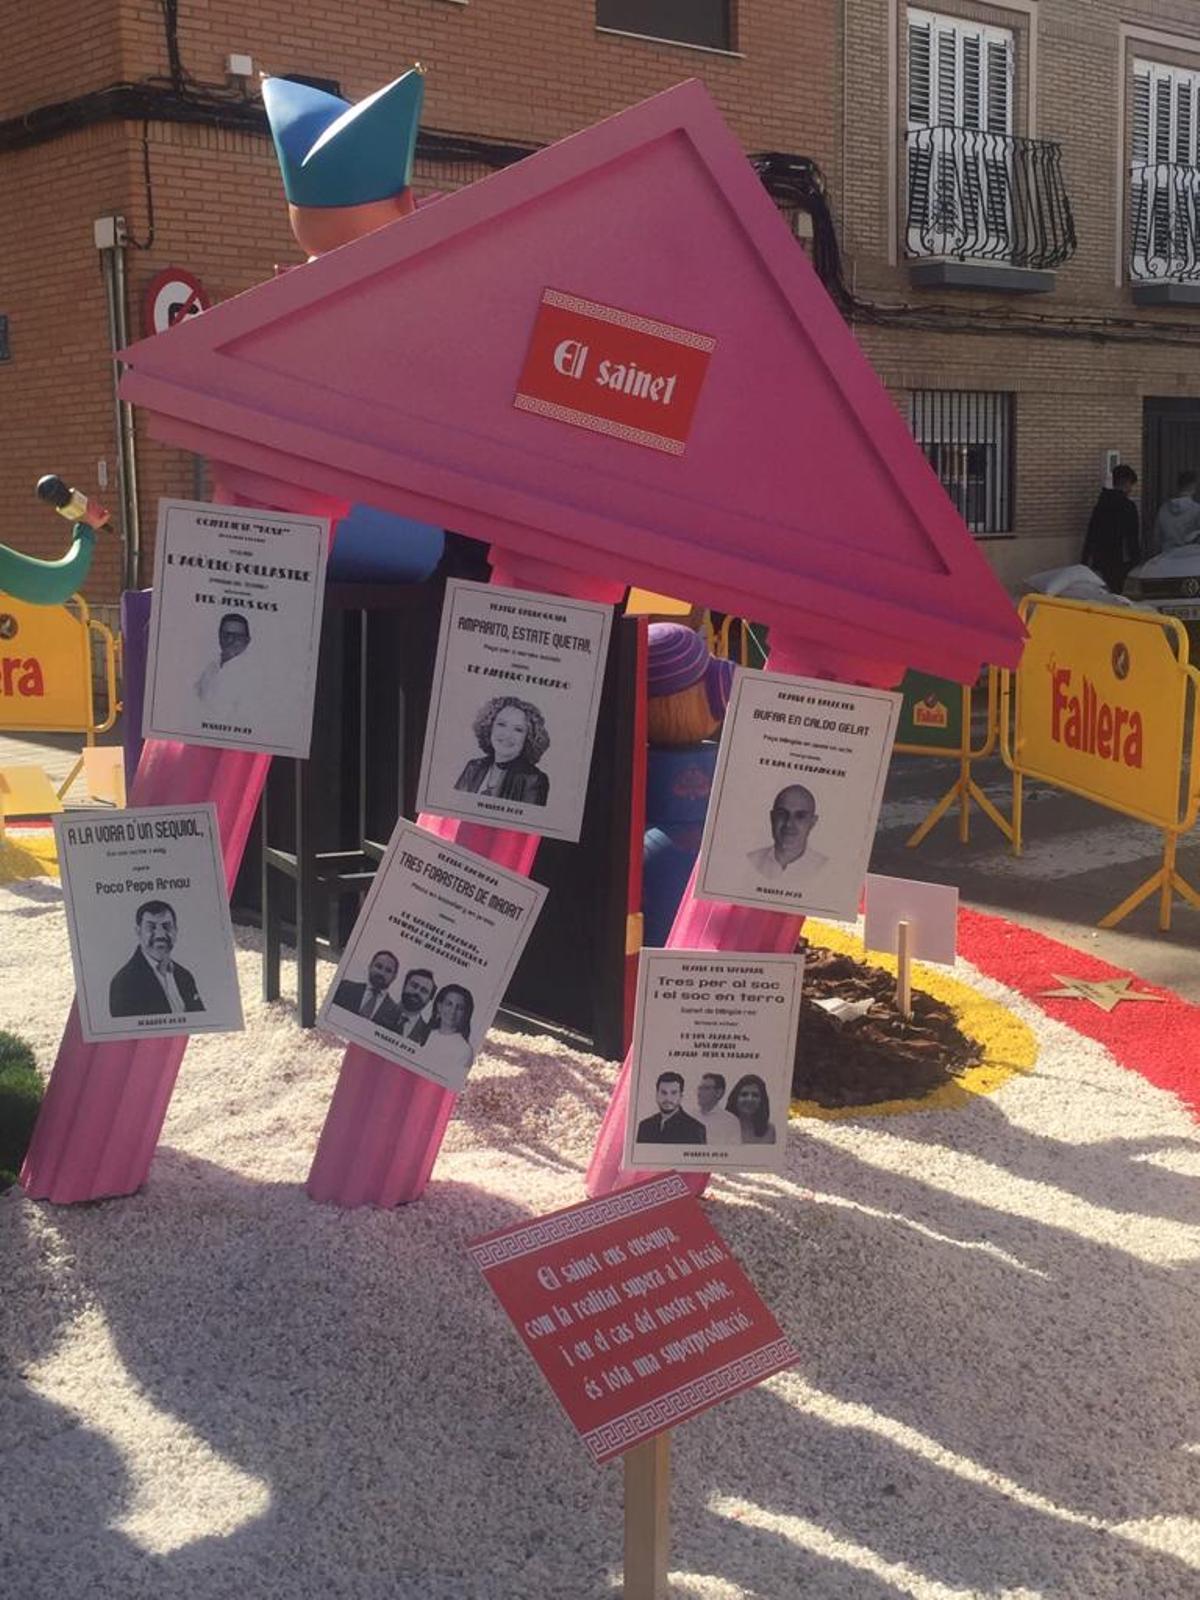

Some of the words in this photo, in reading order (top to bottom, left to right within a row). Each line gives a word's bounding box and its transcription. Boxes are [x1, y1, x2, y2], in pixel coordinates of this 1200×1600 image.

[553, 338, 589, 380] El
[596, 359, 678, 405] sainet
[512, 625, 550, 646] ESTATE
[753, 708, 787, 723] BUFAR
[803, 717, 836, 731] CALDO
[838, 722, 871, 737] GELAT
[1050, 668, 1144, 769] Fallera
[68, 828, 77, 845] A
[78, 827, 94, 844] LA
[94, 823, 125, 843] VORA
[126, 878, 154, 895] Pepe
[400, 851, 424, 872] TRES
[474, 887, 490, 906] DE
[536, 1265, 562, 1291] El
[560, 1252, 603, 1283] sainet
[523, 1313, 557, 1340] com
[552, 1304, 575, 1328] la
[571, 1283, 622, 1319] realitat
[620, 1268, 667, 1299] supera
[665, 1263, 679, 1281] a
[672, 1255, 693, 1277] la
[559, 1345, 575, 1368] i
[574, 1340, 595, 1361] en
[593, 1327, 612, 1351] el
[610, 1321, 635, 1345] cas
[634, 1307, 659, 1334] del
[655, 1295, 698, 1326] nostre
[601, 1365, 635, 1392] tota
[632, 1352, 662, 1378] una
